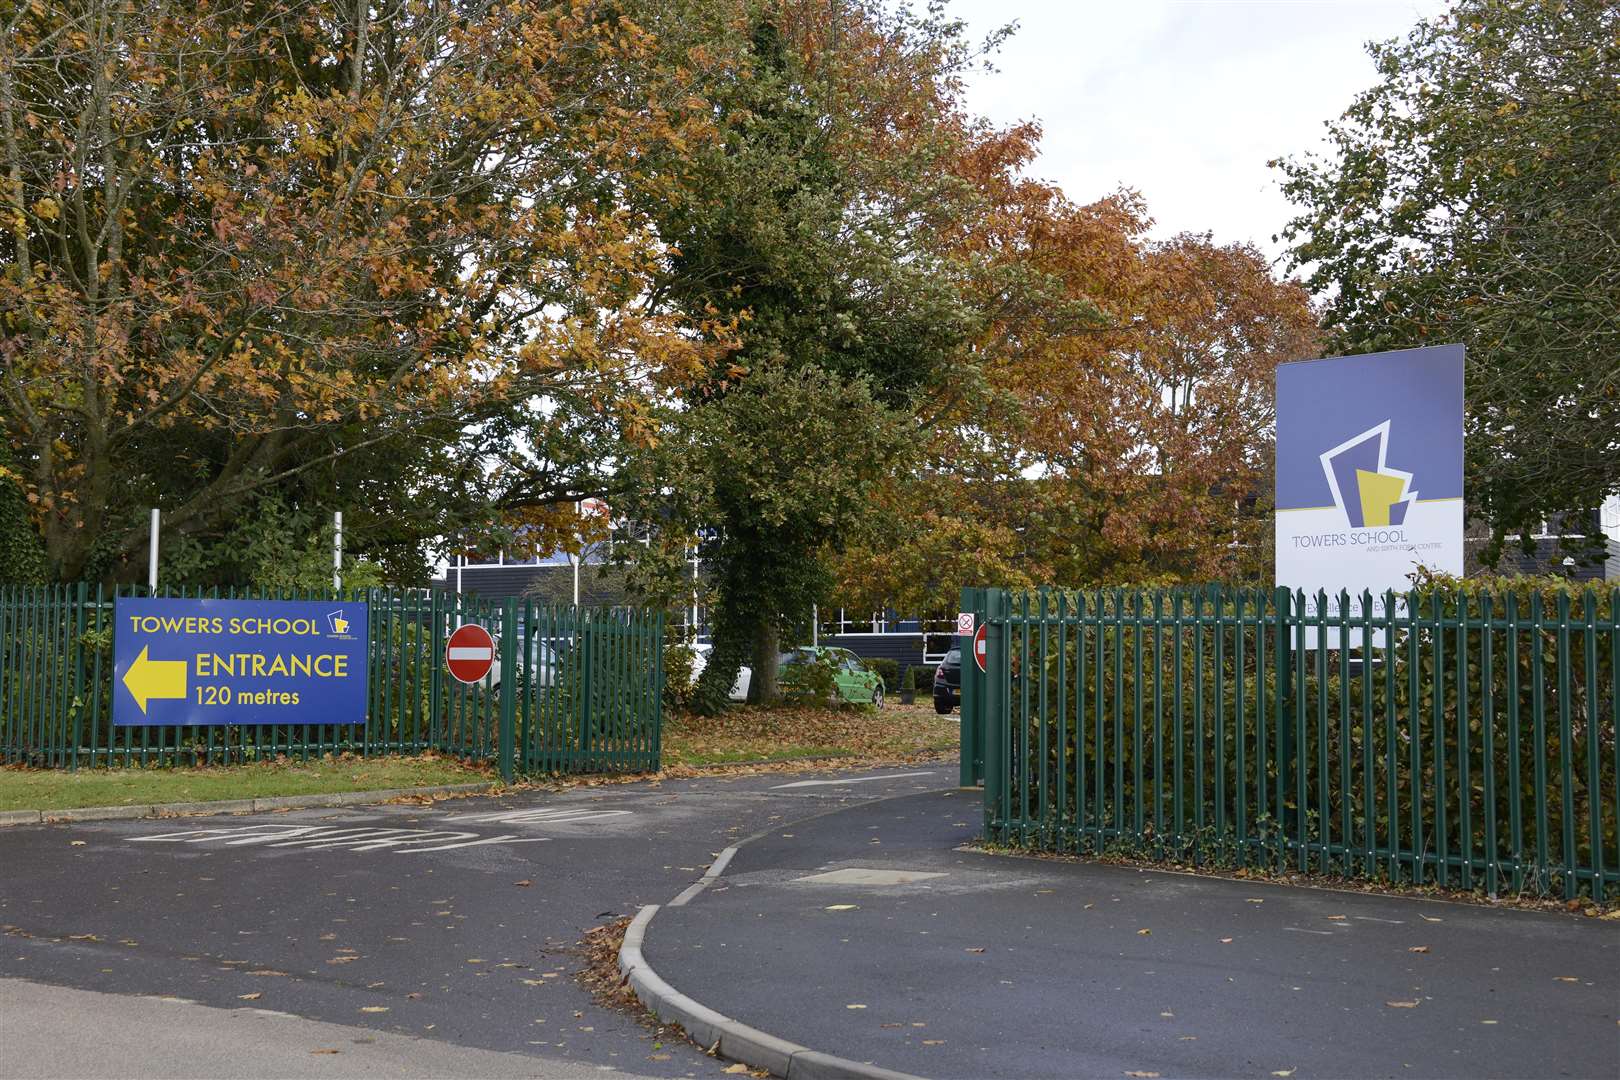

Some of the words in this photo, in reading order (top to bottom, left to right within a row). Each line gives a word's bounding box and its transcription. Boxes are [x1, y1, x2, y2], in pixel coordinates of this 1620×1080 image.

[1292, 533, 1346, 548] TOWERS
[1350, 530, 1408, 545] SCHOOL
[130, 616, 223, 634] TOWERS
[228, 617, 320, 636] SCHOOL
[196, 653, 348, 677] ENTRANCE
[196, 686, 232, 705] 120
[238, 688, 300, 705] metres
[122, 824, 553, 854] ENTRY
